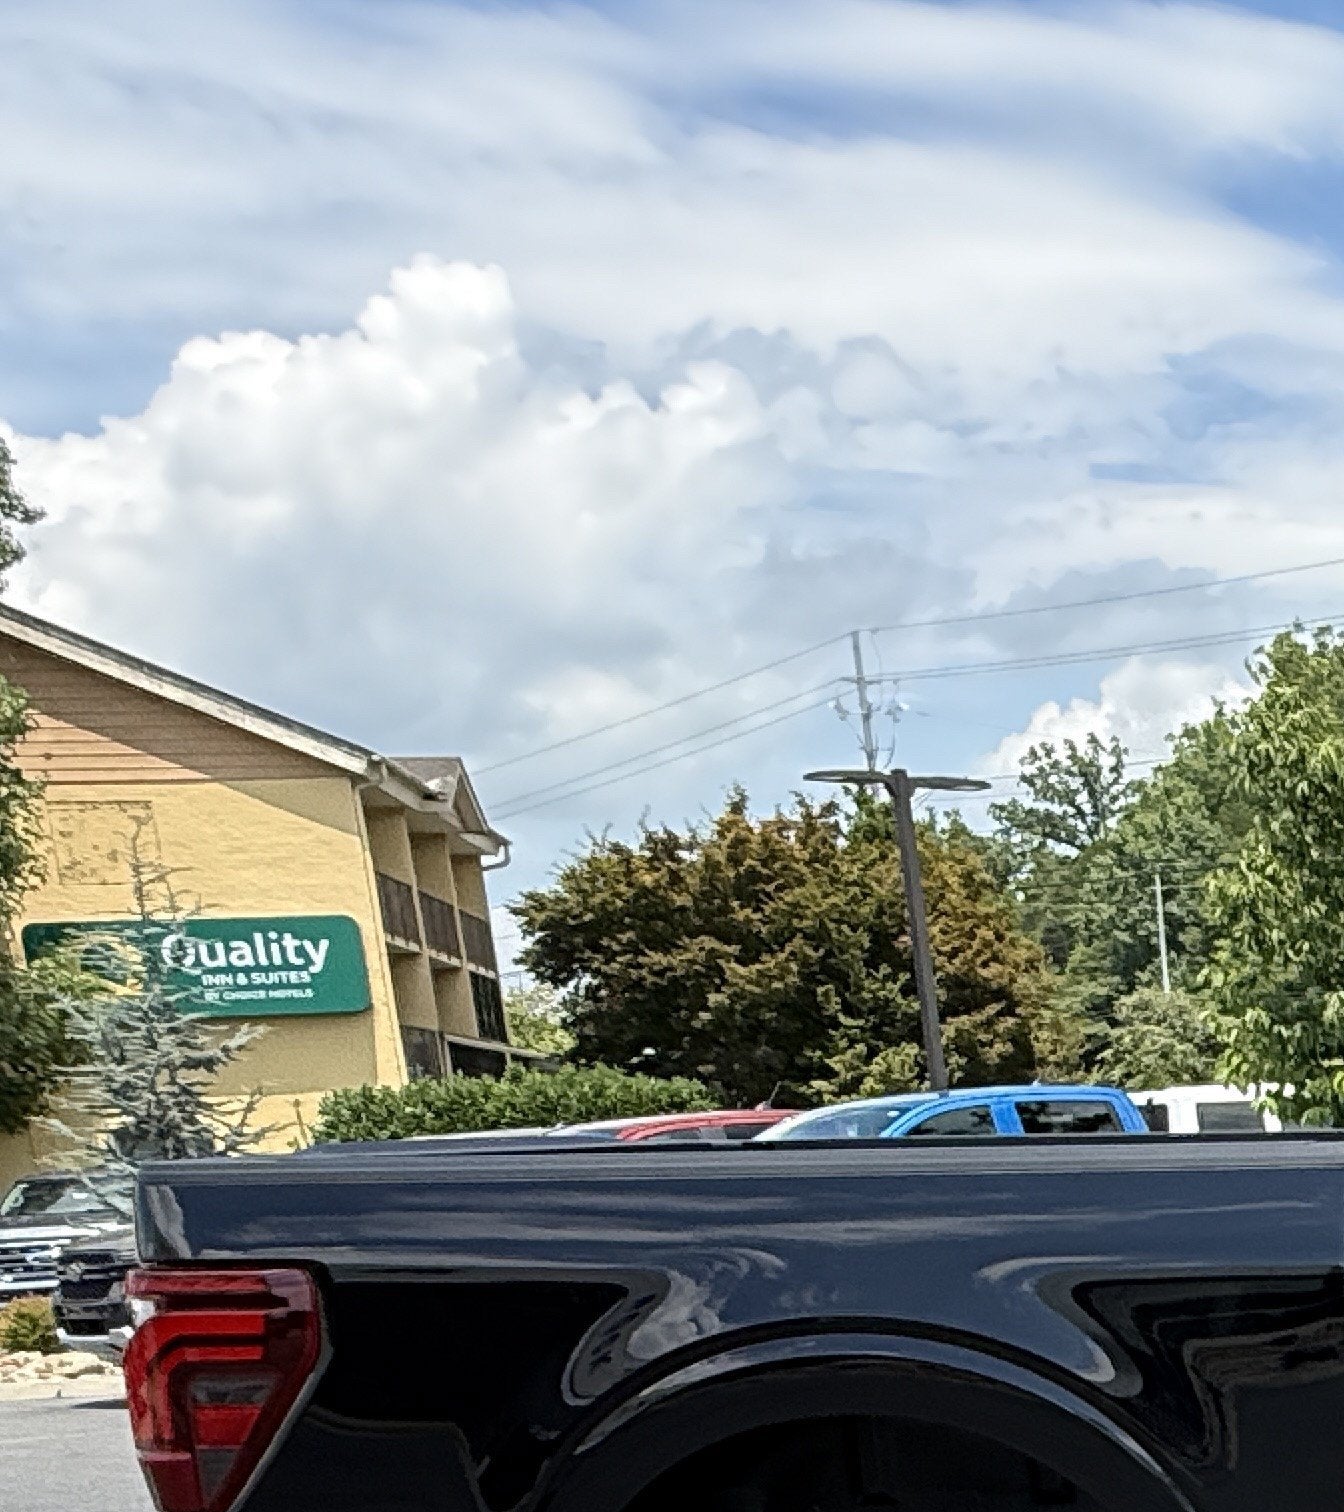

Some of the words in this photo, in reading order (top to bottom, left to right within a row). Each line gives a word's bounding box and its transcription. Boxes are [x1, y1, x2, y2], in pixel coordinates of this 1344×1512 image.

[161, 931, 330, 974] Quality
[201, 973, 234, 986] INN
[236, 972, 249, 986] &
[251, 971, 312, 984] SUITES
